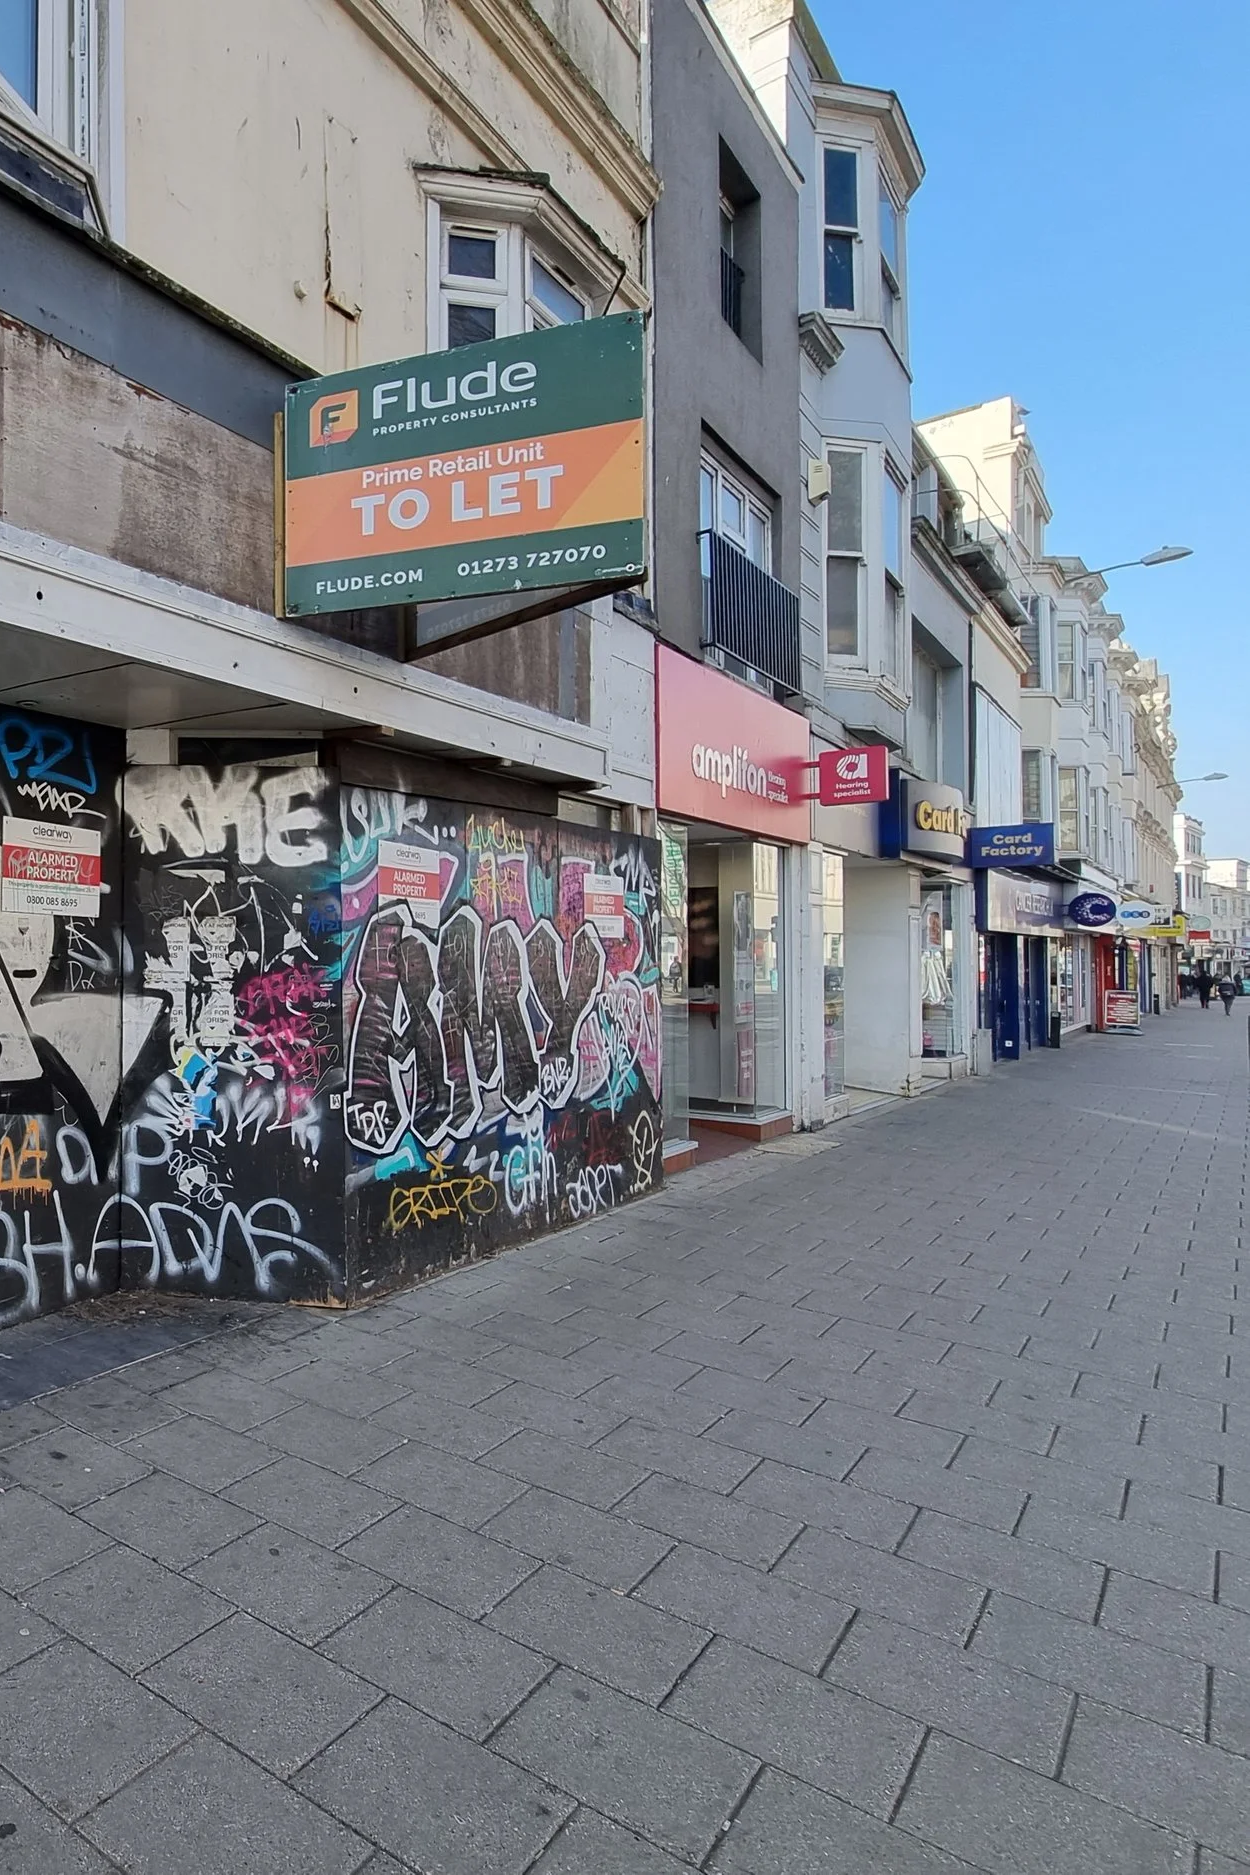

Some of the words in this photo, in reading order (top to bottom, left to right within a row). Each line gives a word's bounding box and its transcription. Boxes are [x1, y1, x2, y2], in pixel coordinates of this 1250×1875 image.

[372, 360, 538, 420] Flude
[372, 418, 437, 437] PROPERTY
[441, 397, 538, 424] CONSULTANTS
[362, 465, 423, 489] Prime
[429, 453, 491, 477] Retail
[497, 442, 544, 466] Unit
[351, 488, 430, 536] TO
[450, 465, 564, 522] LET
[316, 569, 423, 595] FLUDE.COM
[457, 555, 519, 577] 01273
[526, 544, 606, 569] 727070
[692, 743, 767, 799] amplifon
[833, 788, 871, 799] specialist
[836, 781, 869, 789] Hearing
[916, 800, 955, 834] Card
[32, 825, 73, 844] clearway
[992, 832, 1032, 845] Card
[27, 850, 79, 868] ALARMED
[980, 845, 1044, 857] Factory
[26, 866, 80, 883] PROPERTY
[393, 870, 426, 885] ALARMED
[392, 883, 427, 897] PROPERTY
[45, 896, 59, 906] 085
[60, 898, 78, 908] 8695
